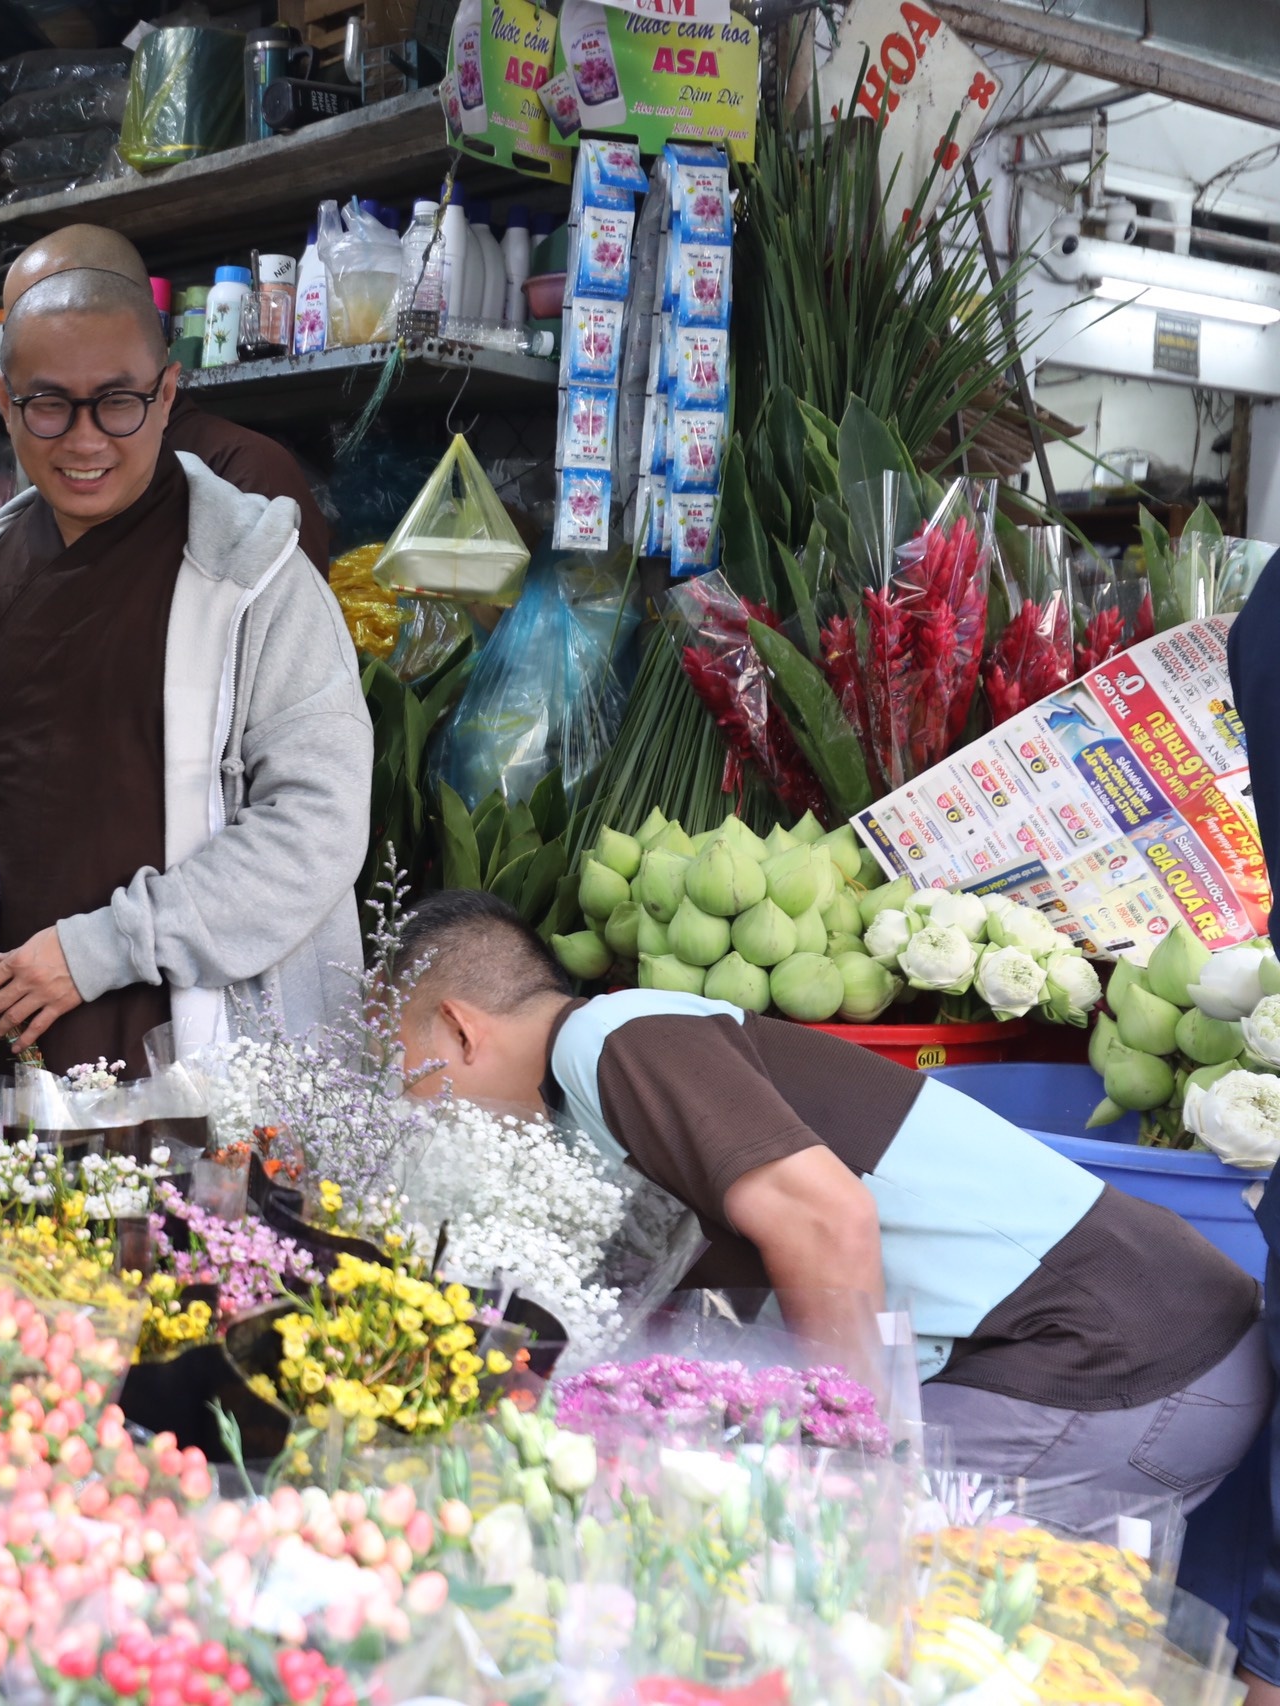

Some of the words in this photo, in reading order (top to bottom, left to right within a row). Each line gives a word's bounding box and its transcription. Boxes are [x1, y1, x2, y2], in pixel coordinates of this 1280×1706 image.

[491, 6, 520, 44] Nước
[524, 20, 550, 54] cảm
[505, 56, 548, 91] ASA
[652, 46, 720, 78] ASA
[856, 2, 941, 129] HOA
[678, 84, 712, 104] Đậm
[716, 87, 744, 107] Đặc
[274, 260, 292, 278] NEW
[1169, 637, 1197, 672] 14.900.000
[1174, 629, 1208, 672] 13.900.000
[1192, 621, 1226, 663] 15.200.000
[1152, 646, 1179, 681] 13.400.000
[1157, 639, 1190, 681] 11.900.000
[1092, 670, 1116, 698] GÓP
[1112, 663, 1147, 698] 0%
[1107, 694, 1132, 720] TRẢ
[1171, 694, 1180, 704] 4K
[1178, 703, 1187, 713] TV
[1125, 721, 1156, 755] ĐẾN
[1143, 706, 1194, 764] TRIỆU
[1186, 713, 1206, 739] GOOGLE
[1033, 734, 1059, 768] 7.790.000
[1095, 746, 1111, 764] BAO
[1146, 750, 1174, 780] SỐC
[1206, 742, 1230, 771] SONY
[990, 759, 1017, 794] 8.990.000
[1163, 774, 1189, 801] GIẢM
[1175, 752, 1214, 791] 3.6
[949, 785, 975, 817] 9.390.000
[1080, 801, 1102, 829] 8.690.000
[1114, 794, 1129, 810] 1.3
[1200, 782, 1235, 823] TRIỆU
[908, 811, 934, 844] 9.990.000
[1222, 817, 1245, 838] 2
[1145, 837, 1182, 875] GIÁ
[1175, 834, 1196, 858] Sắm
[1232, 832, 1264, 869] ĐẾN
[1185, 853, 1208, 876] máy
[1163, 865, 1209, 916] QUÁ
[1197, 870, 1226, 902] nước
[1190, 906, 1228, 945] RẺ
[1212, 896, 1244, 931] nóng
[918, 1050, 944, 1066] 60L
